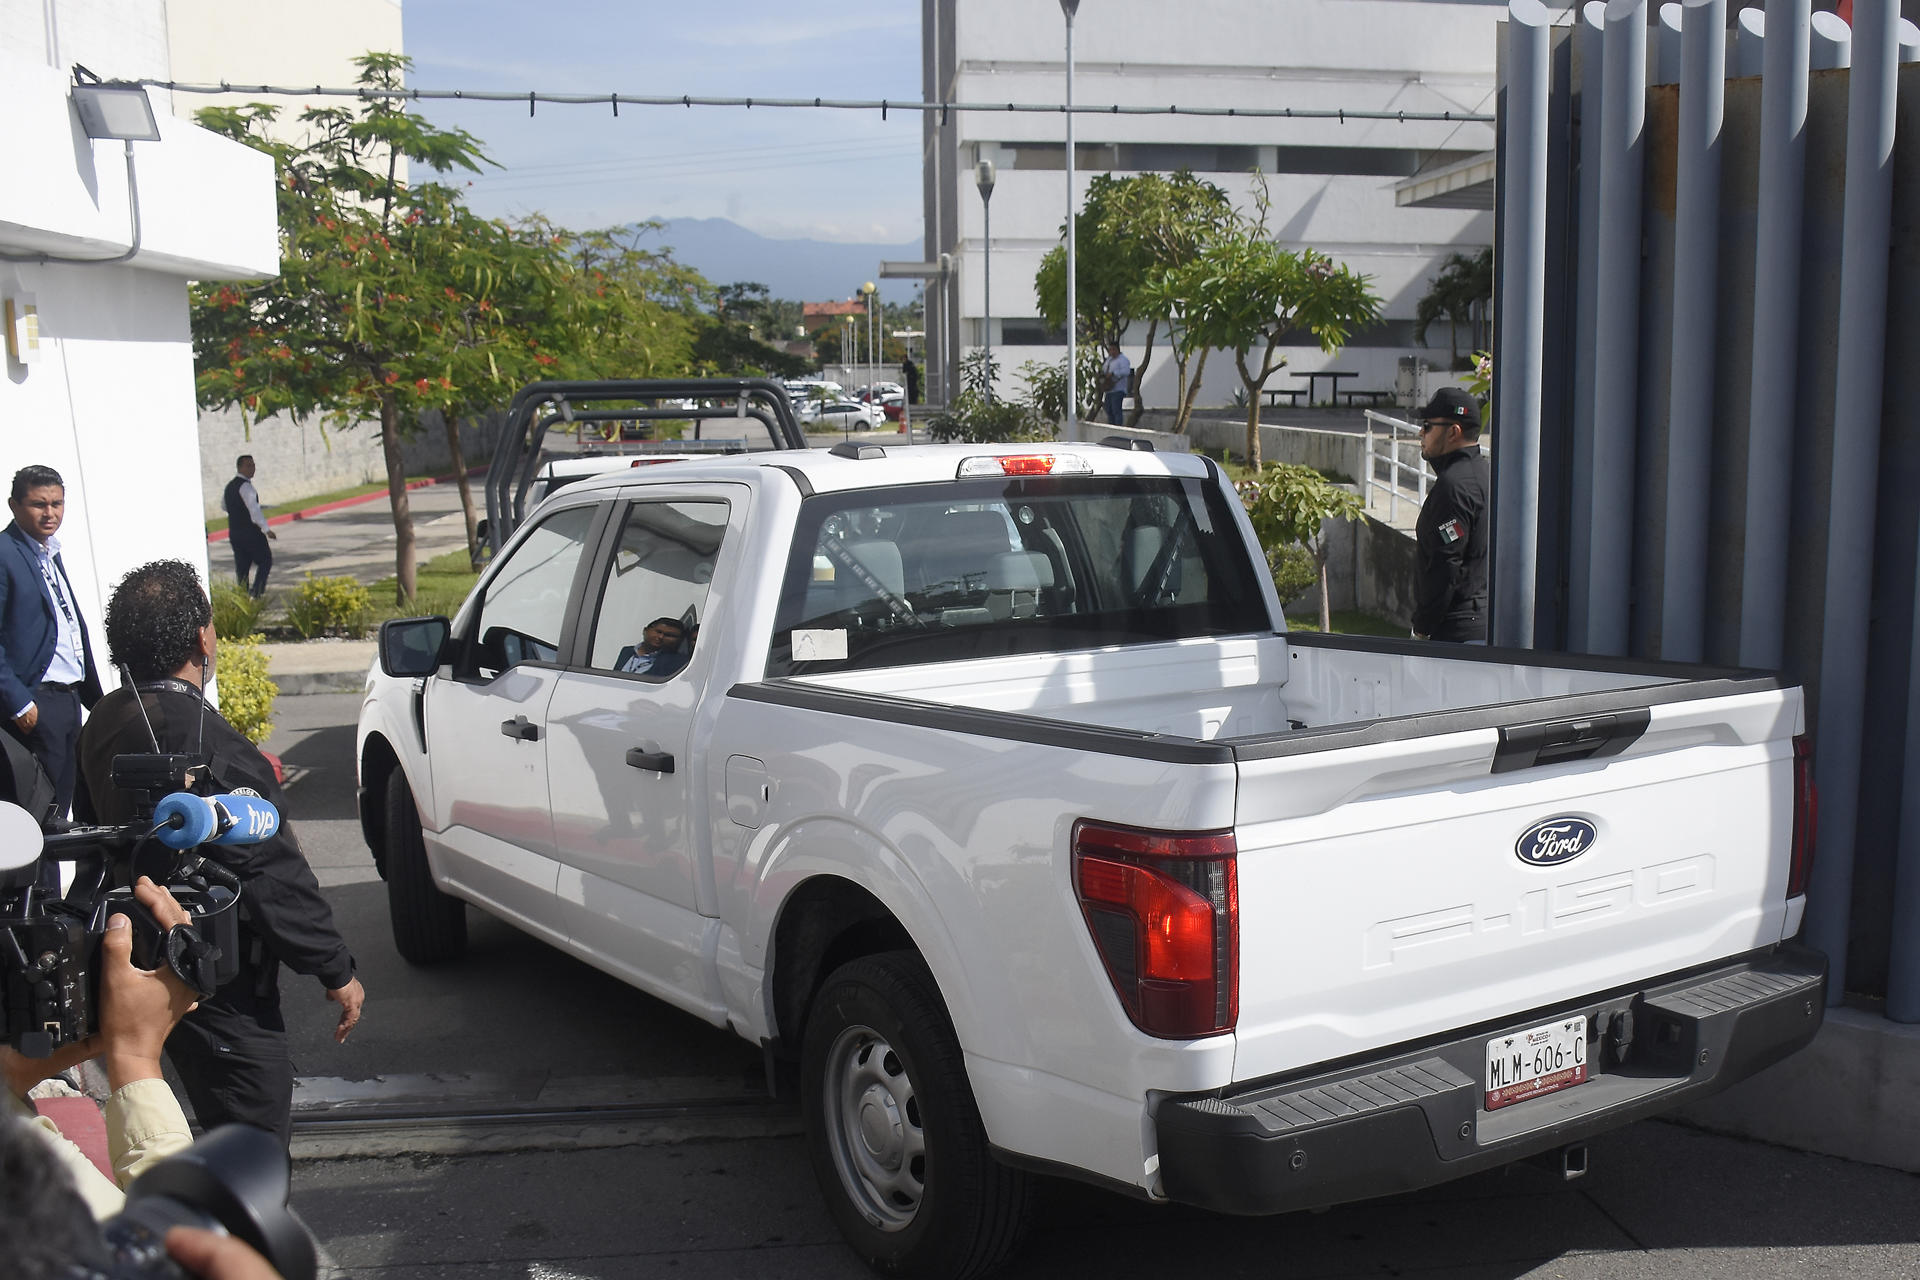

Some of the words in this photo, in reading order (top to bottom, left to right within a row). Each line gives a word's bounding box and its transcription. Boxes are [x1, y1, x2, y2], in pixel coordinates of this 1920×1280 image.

[172, 682, 188, 692] AIC
[247, 804, 274, 840] tve
[1531, 824, 1584, 860] Ford
[1362, 853, 1716, 970] F-150
[1490, 1036, 1583, 1089] MLM-606-C
